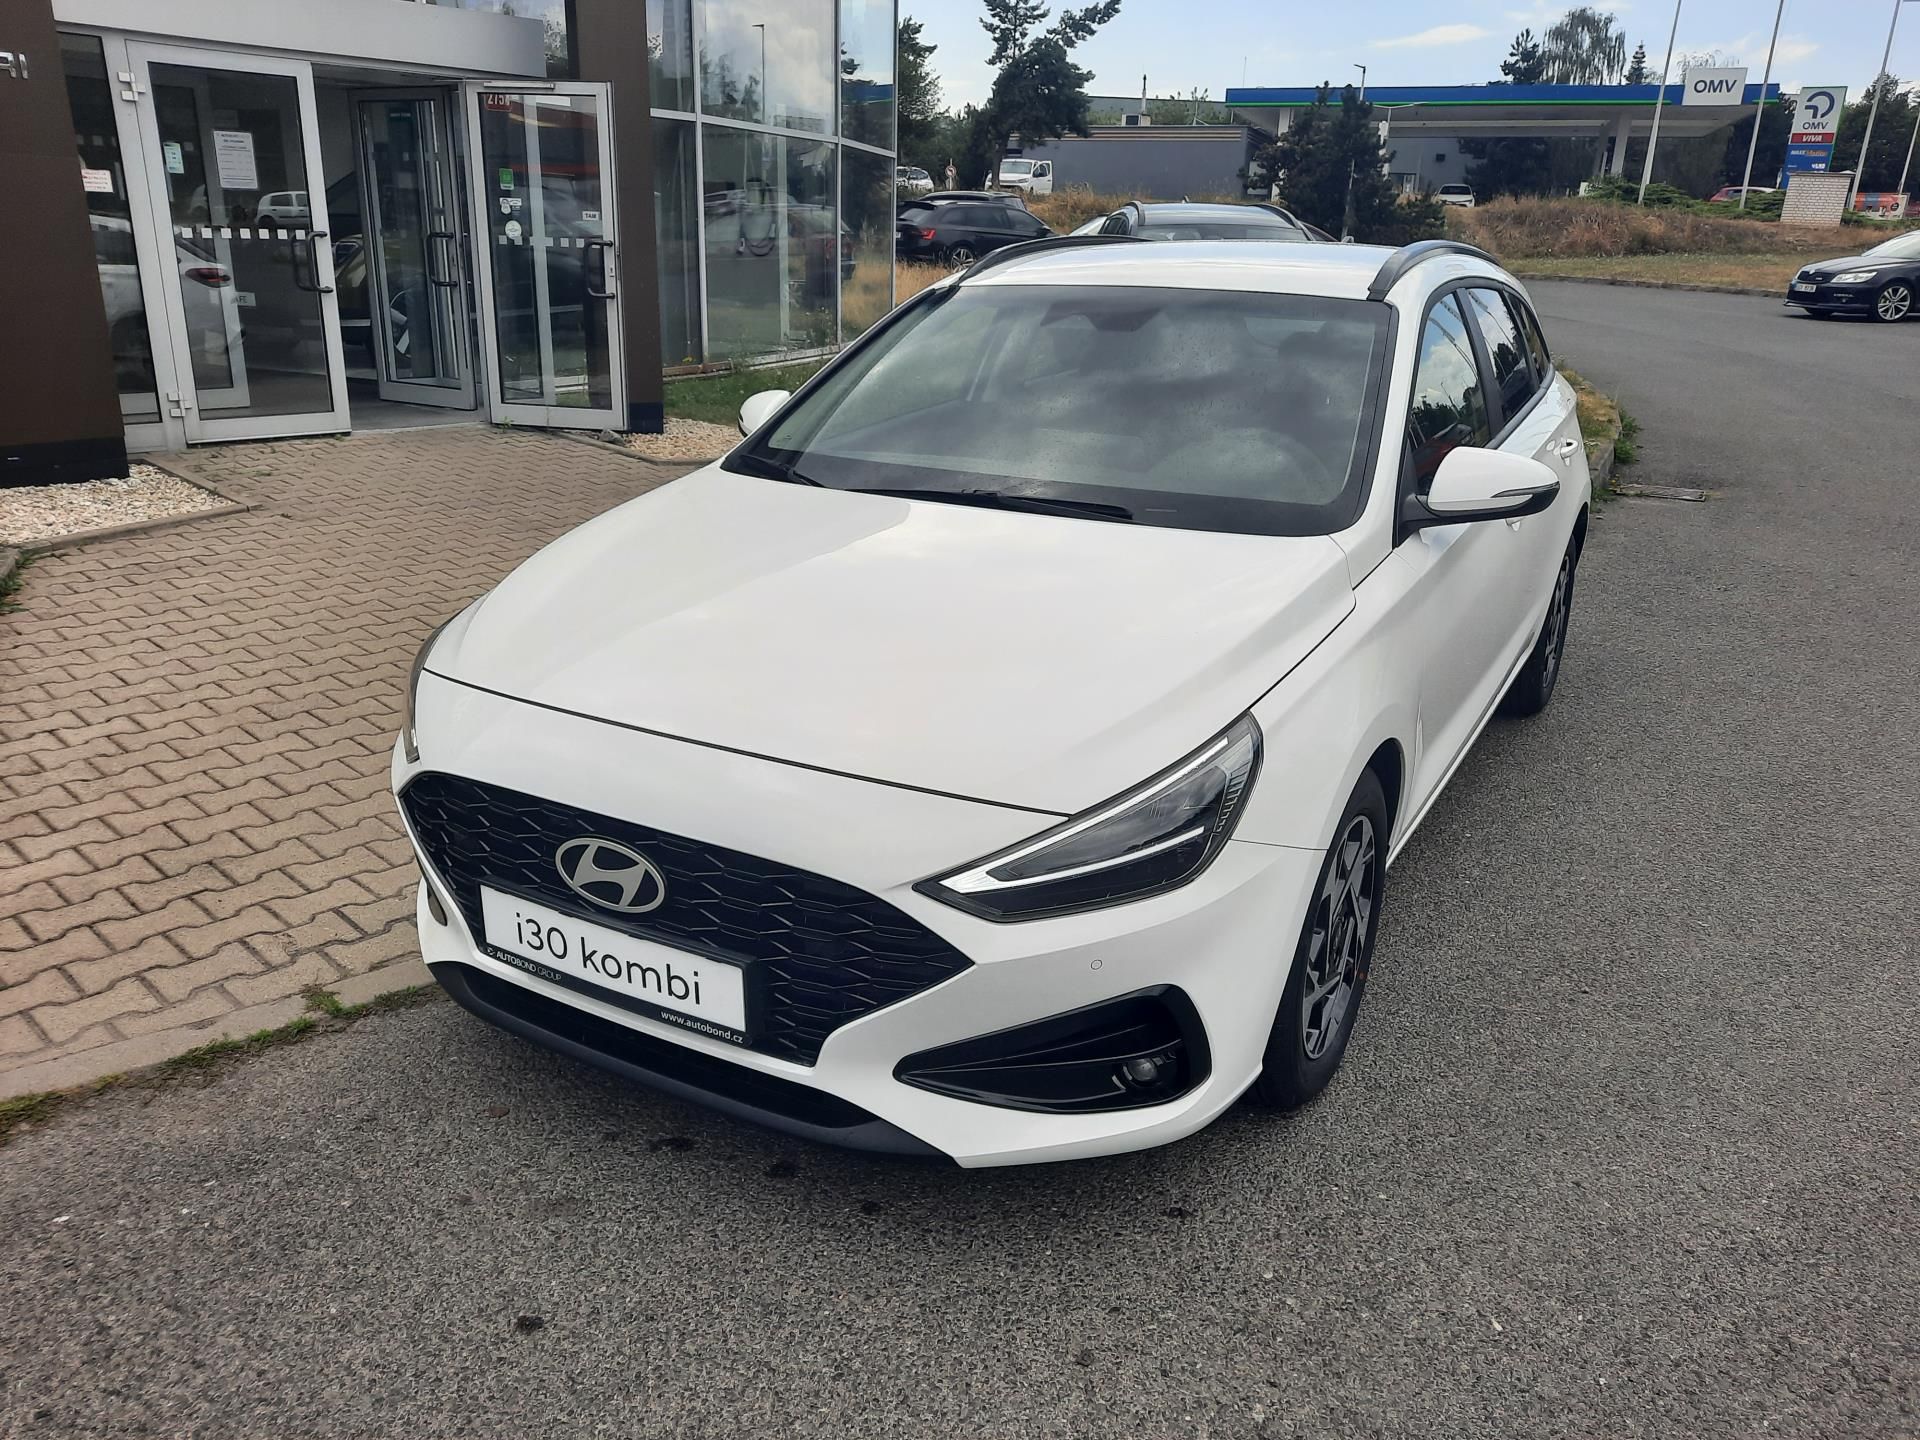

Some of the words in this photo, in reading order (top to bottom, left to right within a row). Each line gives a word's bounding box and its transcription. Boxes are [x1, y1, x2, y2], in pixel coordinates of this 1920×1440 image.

[1693, 79, 1737, 93] OMV
[1802, 121, 1829, 130] OMV
[1802, 134, 1823, 142] VIVA
[496, 950, 537, 972] AUTOBOND
[537, 966, 562, 981] GROUP
[515, 911, 568, 960] i30
[580, 936, 701, 1006] kombi
[660, 1011, 744, 1044] www.autobond.cz
